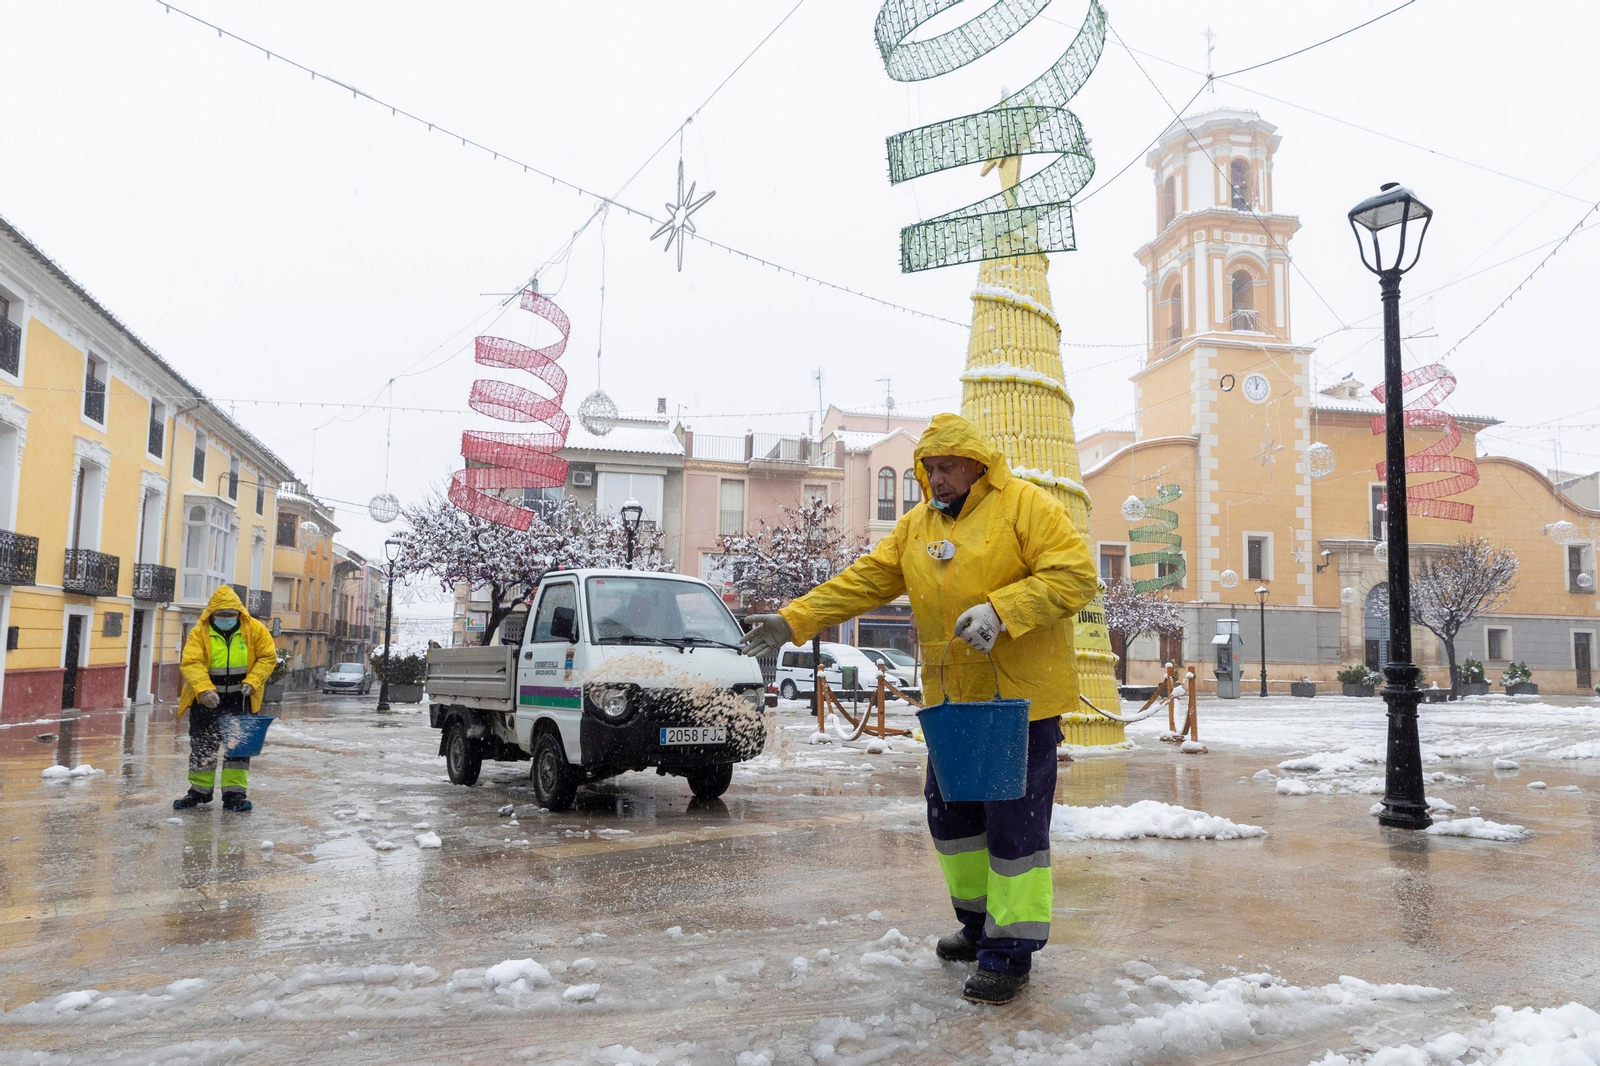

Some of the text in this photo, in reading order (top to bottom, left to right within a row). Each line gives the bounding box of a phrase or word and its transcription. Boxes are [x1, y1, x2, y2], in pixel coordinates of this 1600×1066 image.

[1078, 608, 1103, 625] ¡ÚNETE
[668, 728, 724, 743] 2058 FJZ
